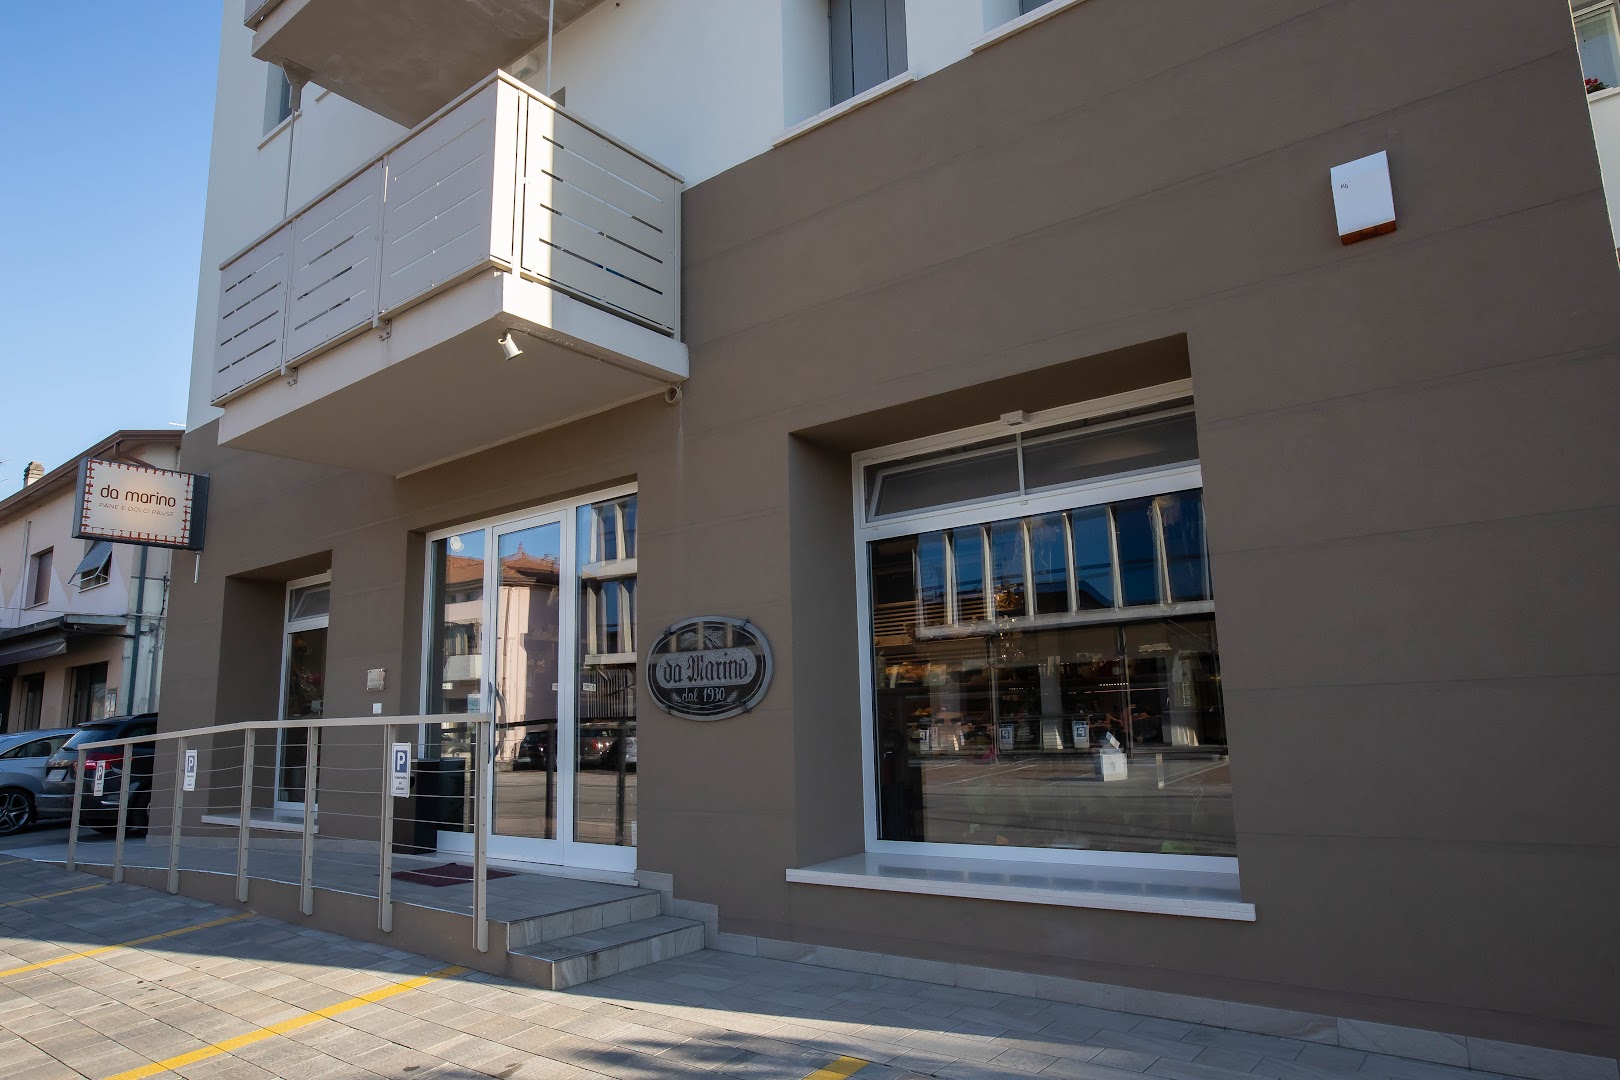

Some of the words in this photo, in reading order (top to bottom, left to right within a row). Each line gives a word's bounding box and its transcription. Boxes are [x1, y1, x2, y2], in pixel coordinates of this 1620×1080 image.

[100, 484, 119, 500] da
[125, 490, 176, 508] marino
[99, 502, 120, 510] PANE
[127, 505, 150, 514] DOLCI
[663, 658, 682, 684] da
[686, 651, 748, 683] Marino
[681, 687, 698, 702] dal
[702, 687, 726, 702] 1930
[188, 756, 194, 771] P
[396, 751, 406, 771] P
